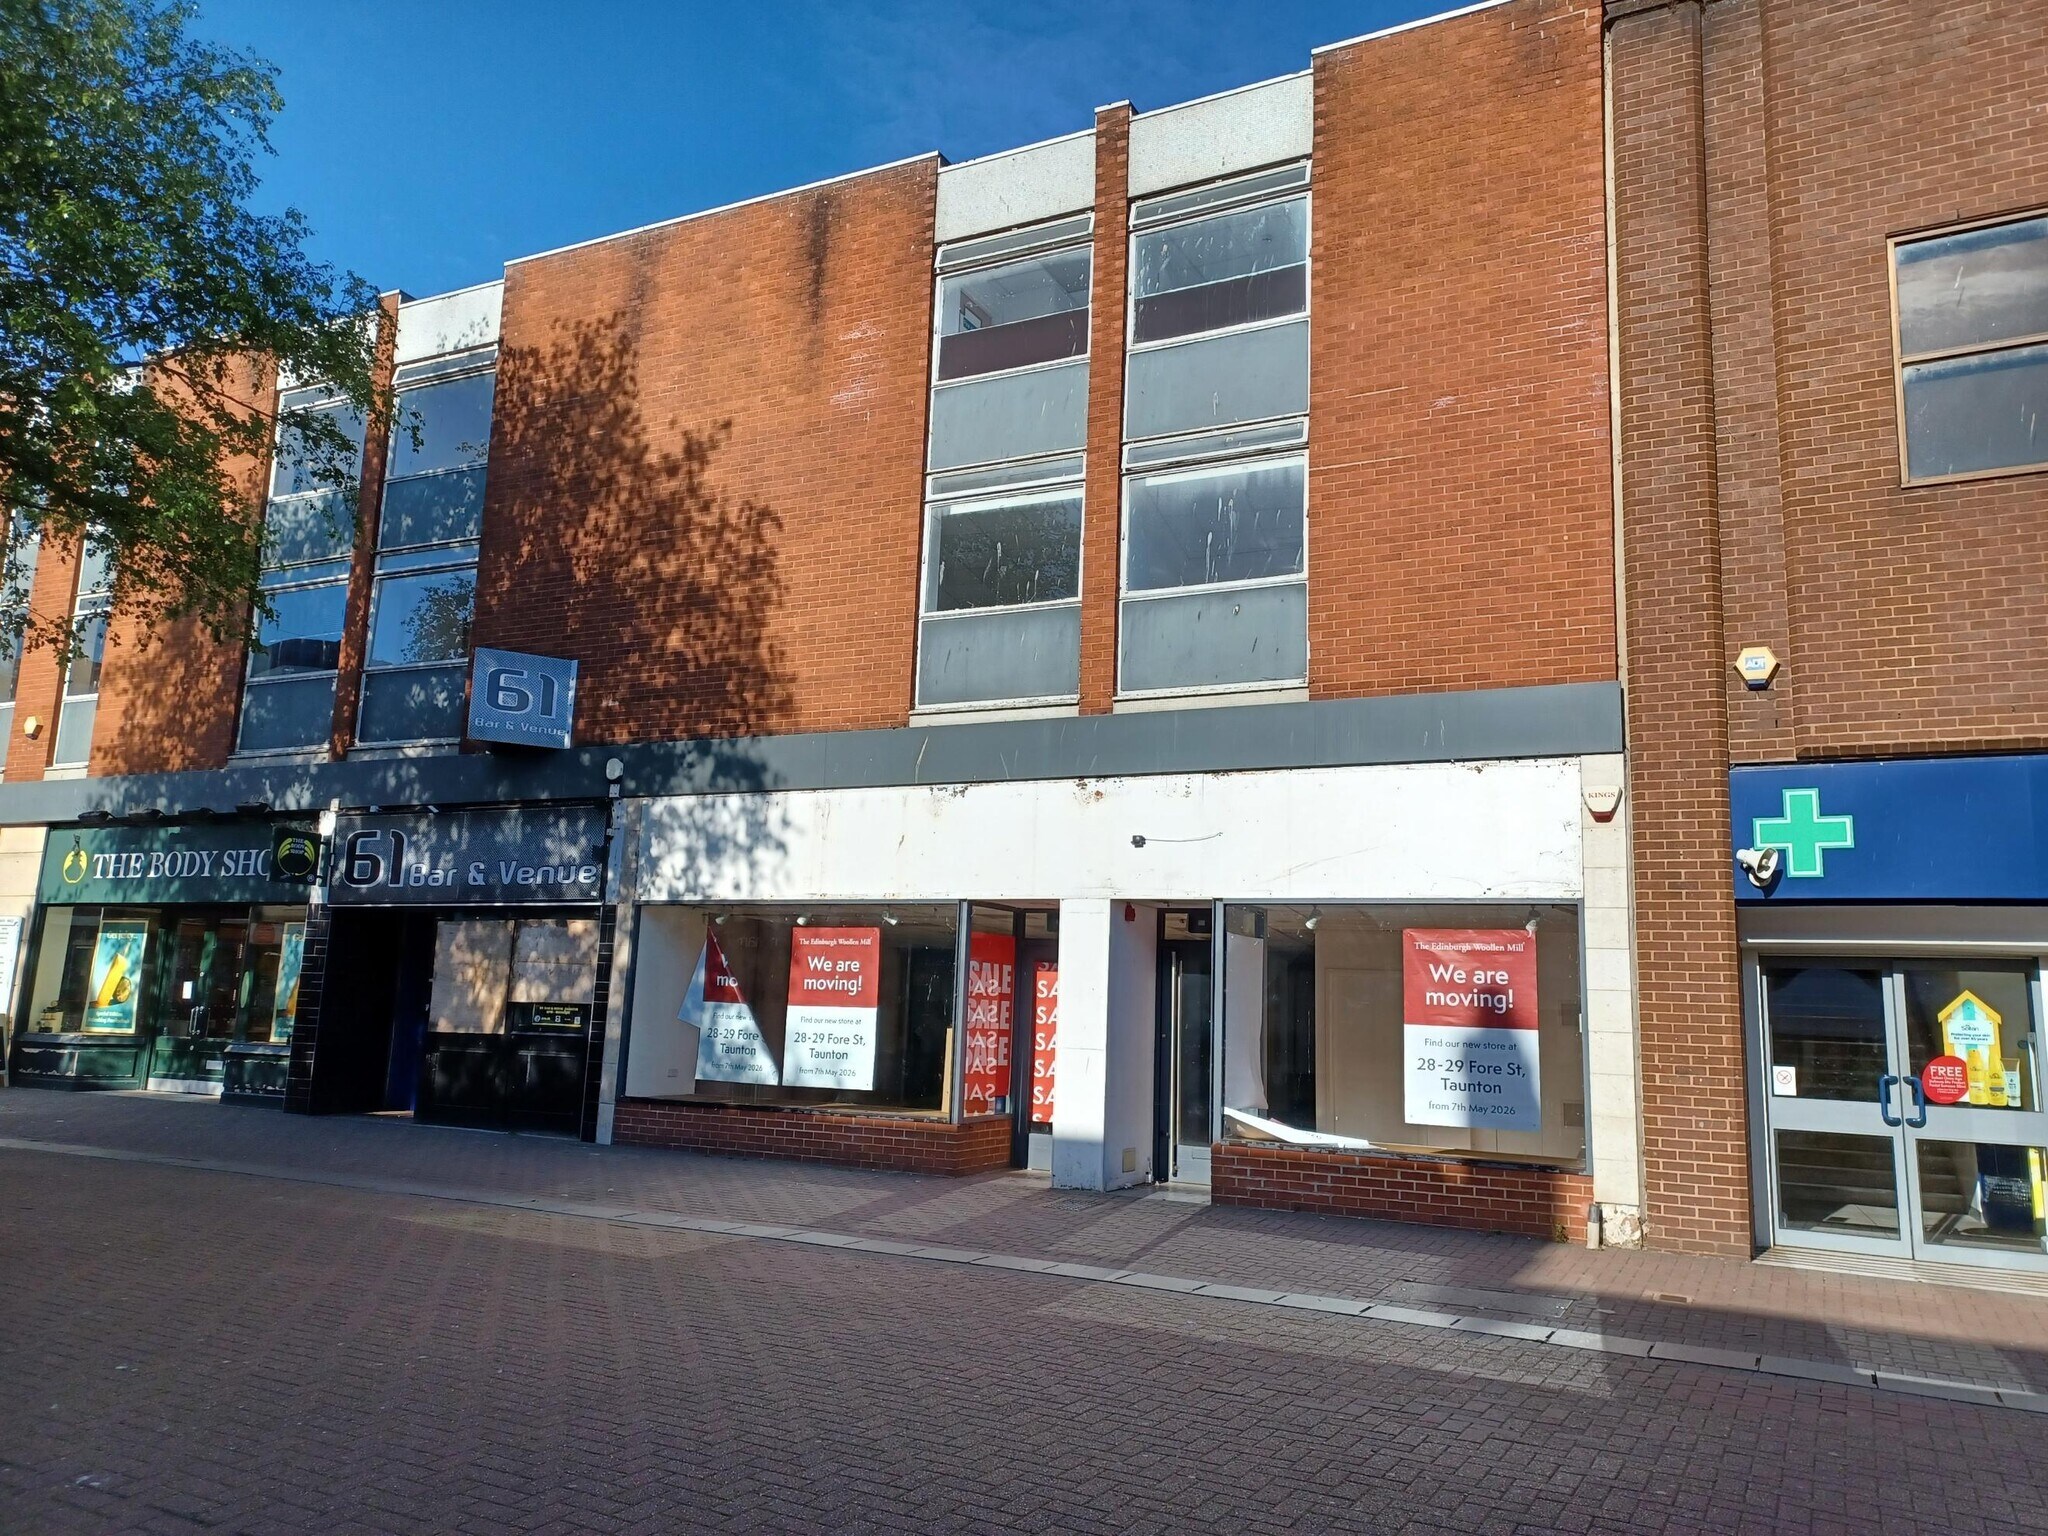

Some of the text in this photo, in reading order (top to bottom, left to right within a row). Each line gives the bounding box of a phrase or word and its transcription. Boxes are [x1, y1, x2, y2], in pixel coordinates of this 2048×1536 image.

[1745, 657, 1765, 669] ADT
[486, 667, 558, 719] 61
[475, 718, 567, 736] Bar & Venue
[93, 852, 145, 879] THE
[147, 850, 219, 878] BODY
[343, 829, 598, 888] 61 Bar & Venue
[811, 938, 837, 947] Edinburgh
[838, 938, 859, 946] Woollen
[1414, 941, 1525, 953] The Edinburgh Woollen Mill
[807, 955, 860, 973] We are
[1429, 963, 1510, 985] We are
[803, 975, 862, 996] moving!
[1425, 988, 1514, 1014] moving!
[713, 1012, 724, 1020] Find
[800, 1016, 813, 1024] Find
[855, 1018, 862, 1026] at
[707, 1028, 759, 1041] 28-29 Fore
[794, 1032, 866, 1047] 28-29 Fore St,
[720, 1043, 756, 1056] Taunton
[1424, 1038, 1517, 1051] Find our new store at
[809, 1048, 849, 1060] Taunton
[734, 1064, 747, 1072] May
[799, 1066, 857, 1078] from 7th May 2026
[1417, 1057, 1526, 1078] 28-29 Fore St,
[1930, 1065, 1963, 1078] FREE
[1441, 1077, 1502, 1094] Taunton
[1428, 1100, 1516, 1116] from 7th May 2026
